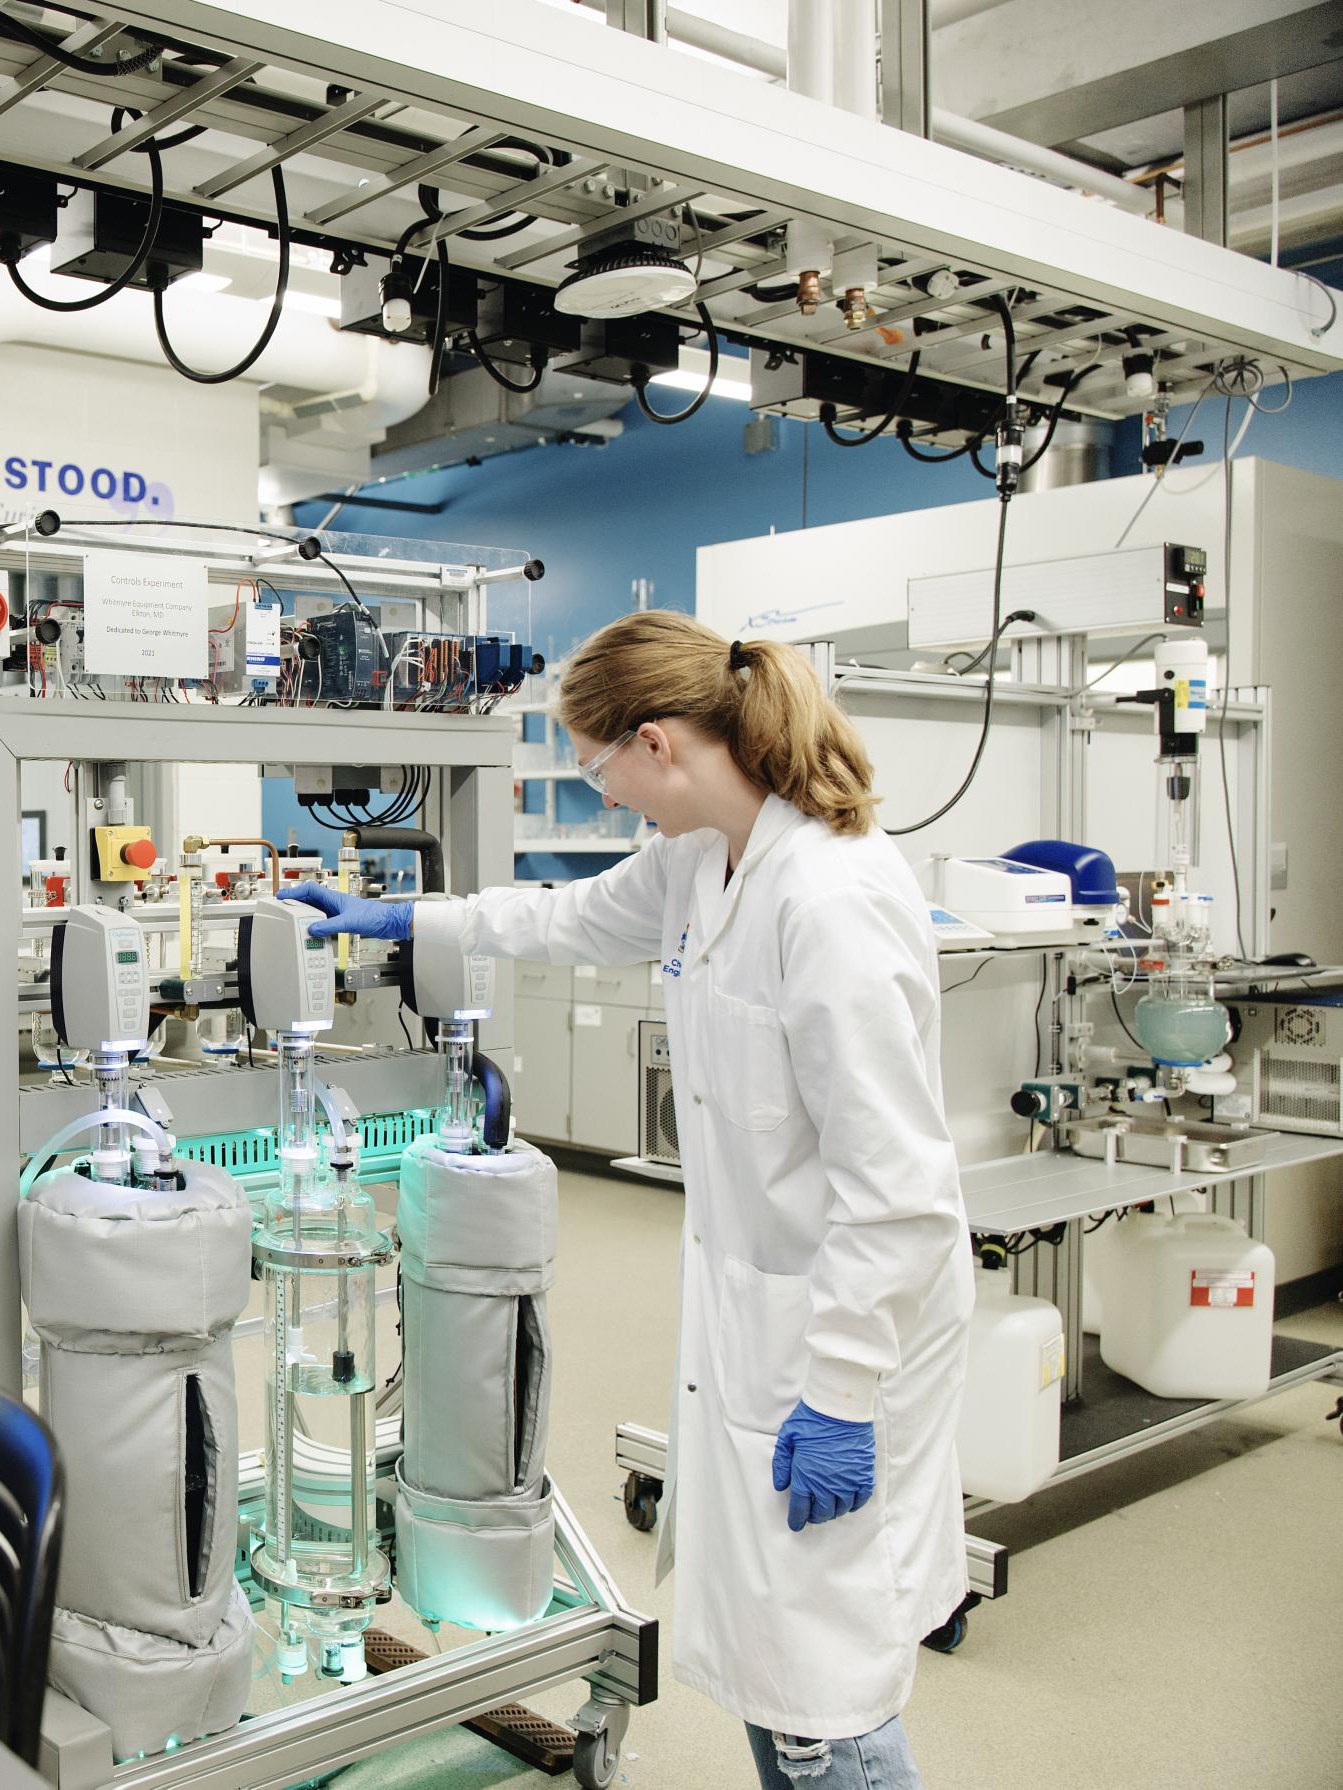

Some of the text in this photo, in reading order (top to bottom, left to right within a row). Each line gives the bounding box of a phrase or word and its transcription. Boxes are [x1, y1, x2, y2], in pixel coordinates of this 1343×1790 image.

[110, 575, 183, 589] Controls Experiment
[102, 597, 193, 613] Whitmyre Equipment Company
[106, 626, 134, 634] Dedicated
[141, 628, 162, 637] George
[162, 629, 190, 638] Whitmyre
[141, 649, 155, 657] 2021
